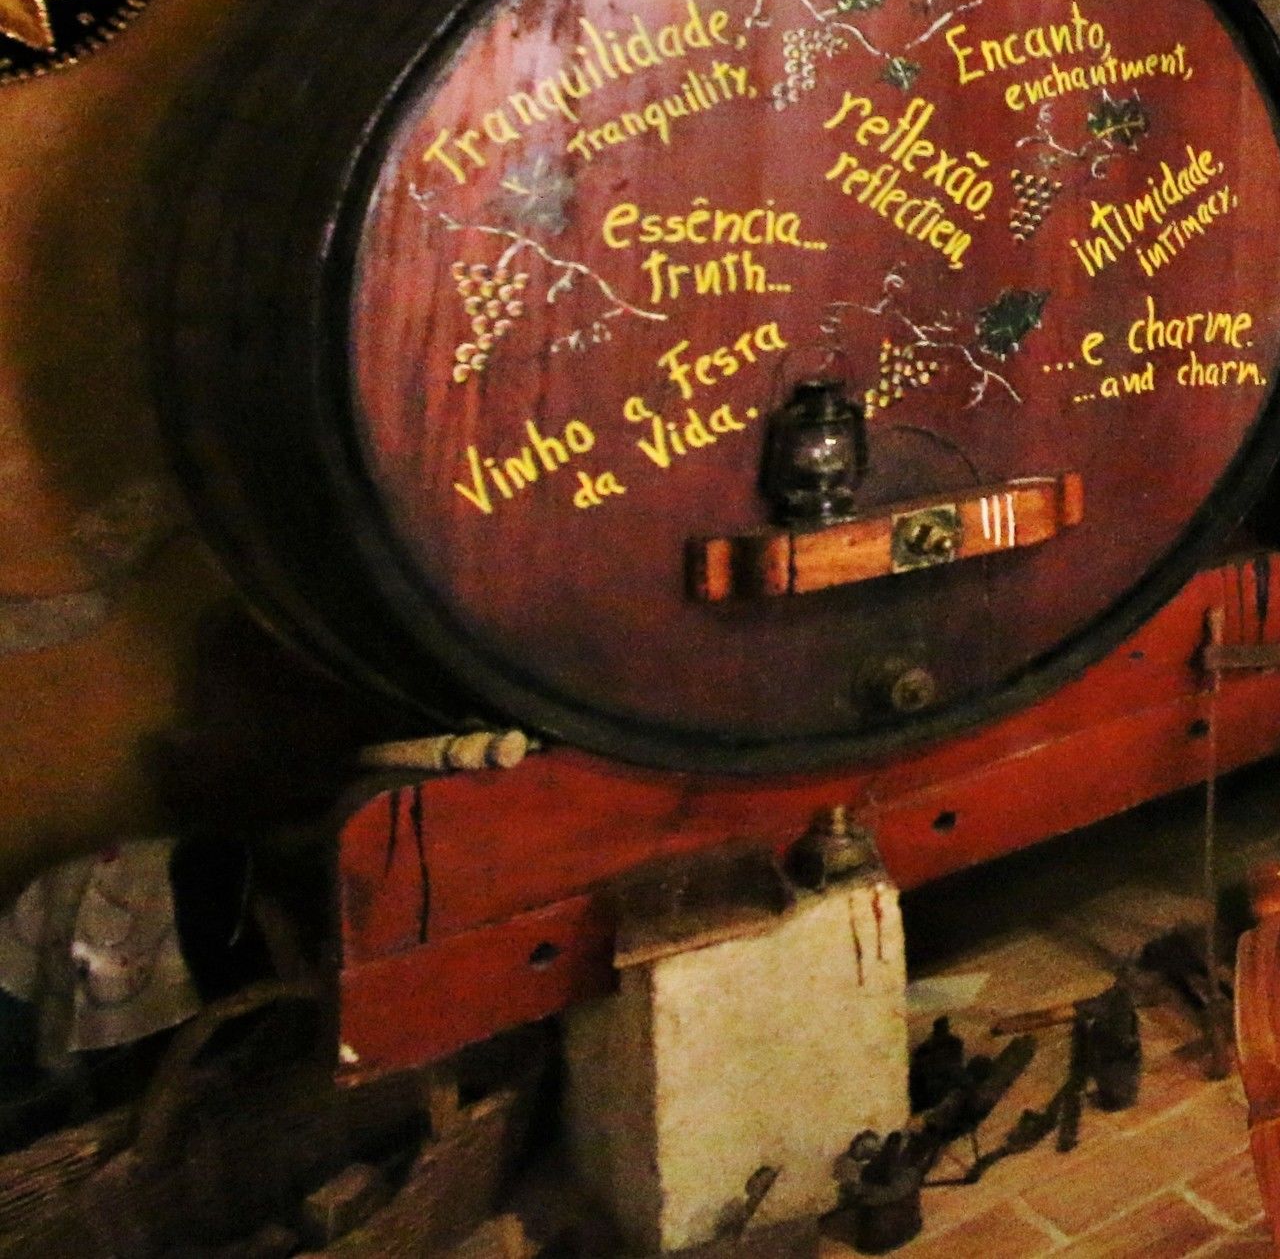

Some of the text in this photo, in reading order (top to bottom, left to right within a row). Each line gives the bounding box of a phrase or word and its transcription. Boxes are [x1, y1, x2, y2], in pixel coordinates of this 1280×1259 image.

[945, 1, 1112, 86] Encanto,
[454, 419, 596, 515] Vinho
[573, 471, 627, 510] da
